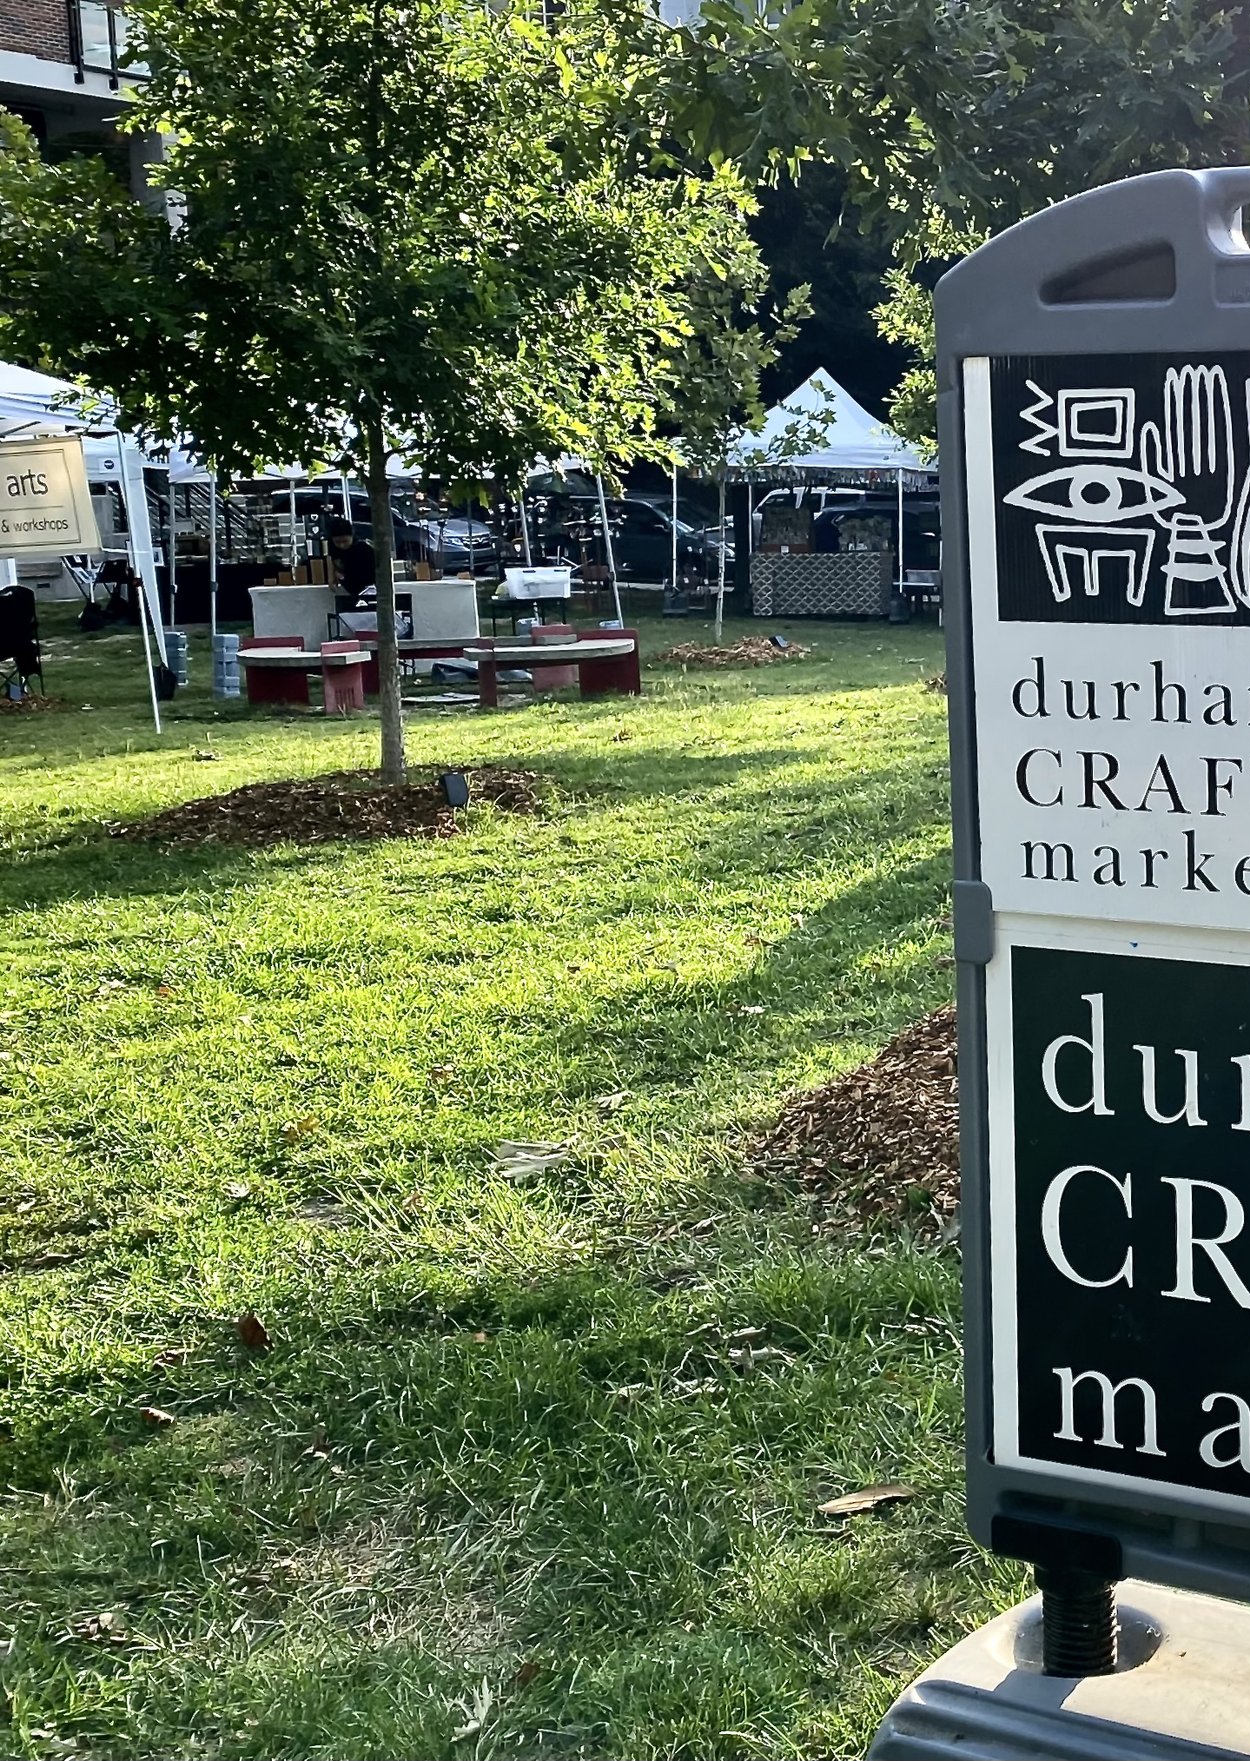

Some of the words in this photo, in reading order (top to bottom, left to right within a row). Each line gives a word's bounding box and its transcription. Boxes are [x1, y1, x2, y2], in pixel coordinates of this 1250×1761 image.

[6, 469, 49, 497] arts
[1, 519, 10, 533] &
[13, 517, 69, 532] workshops
